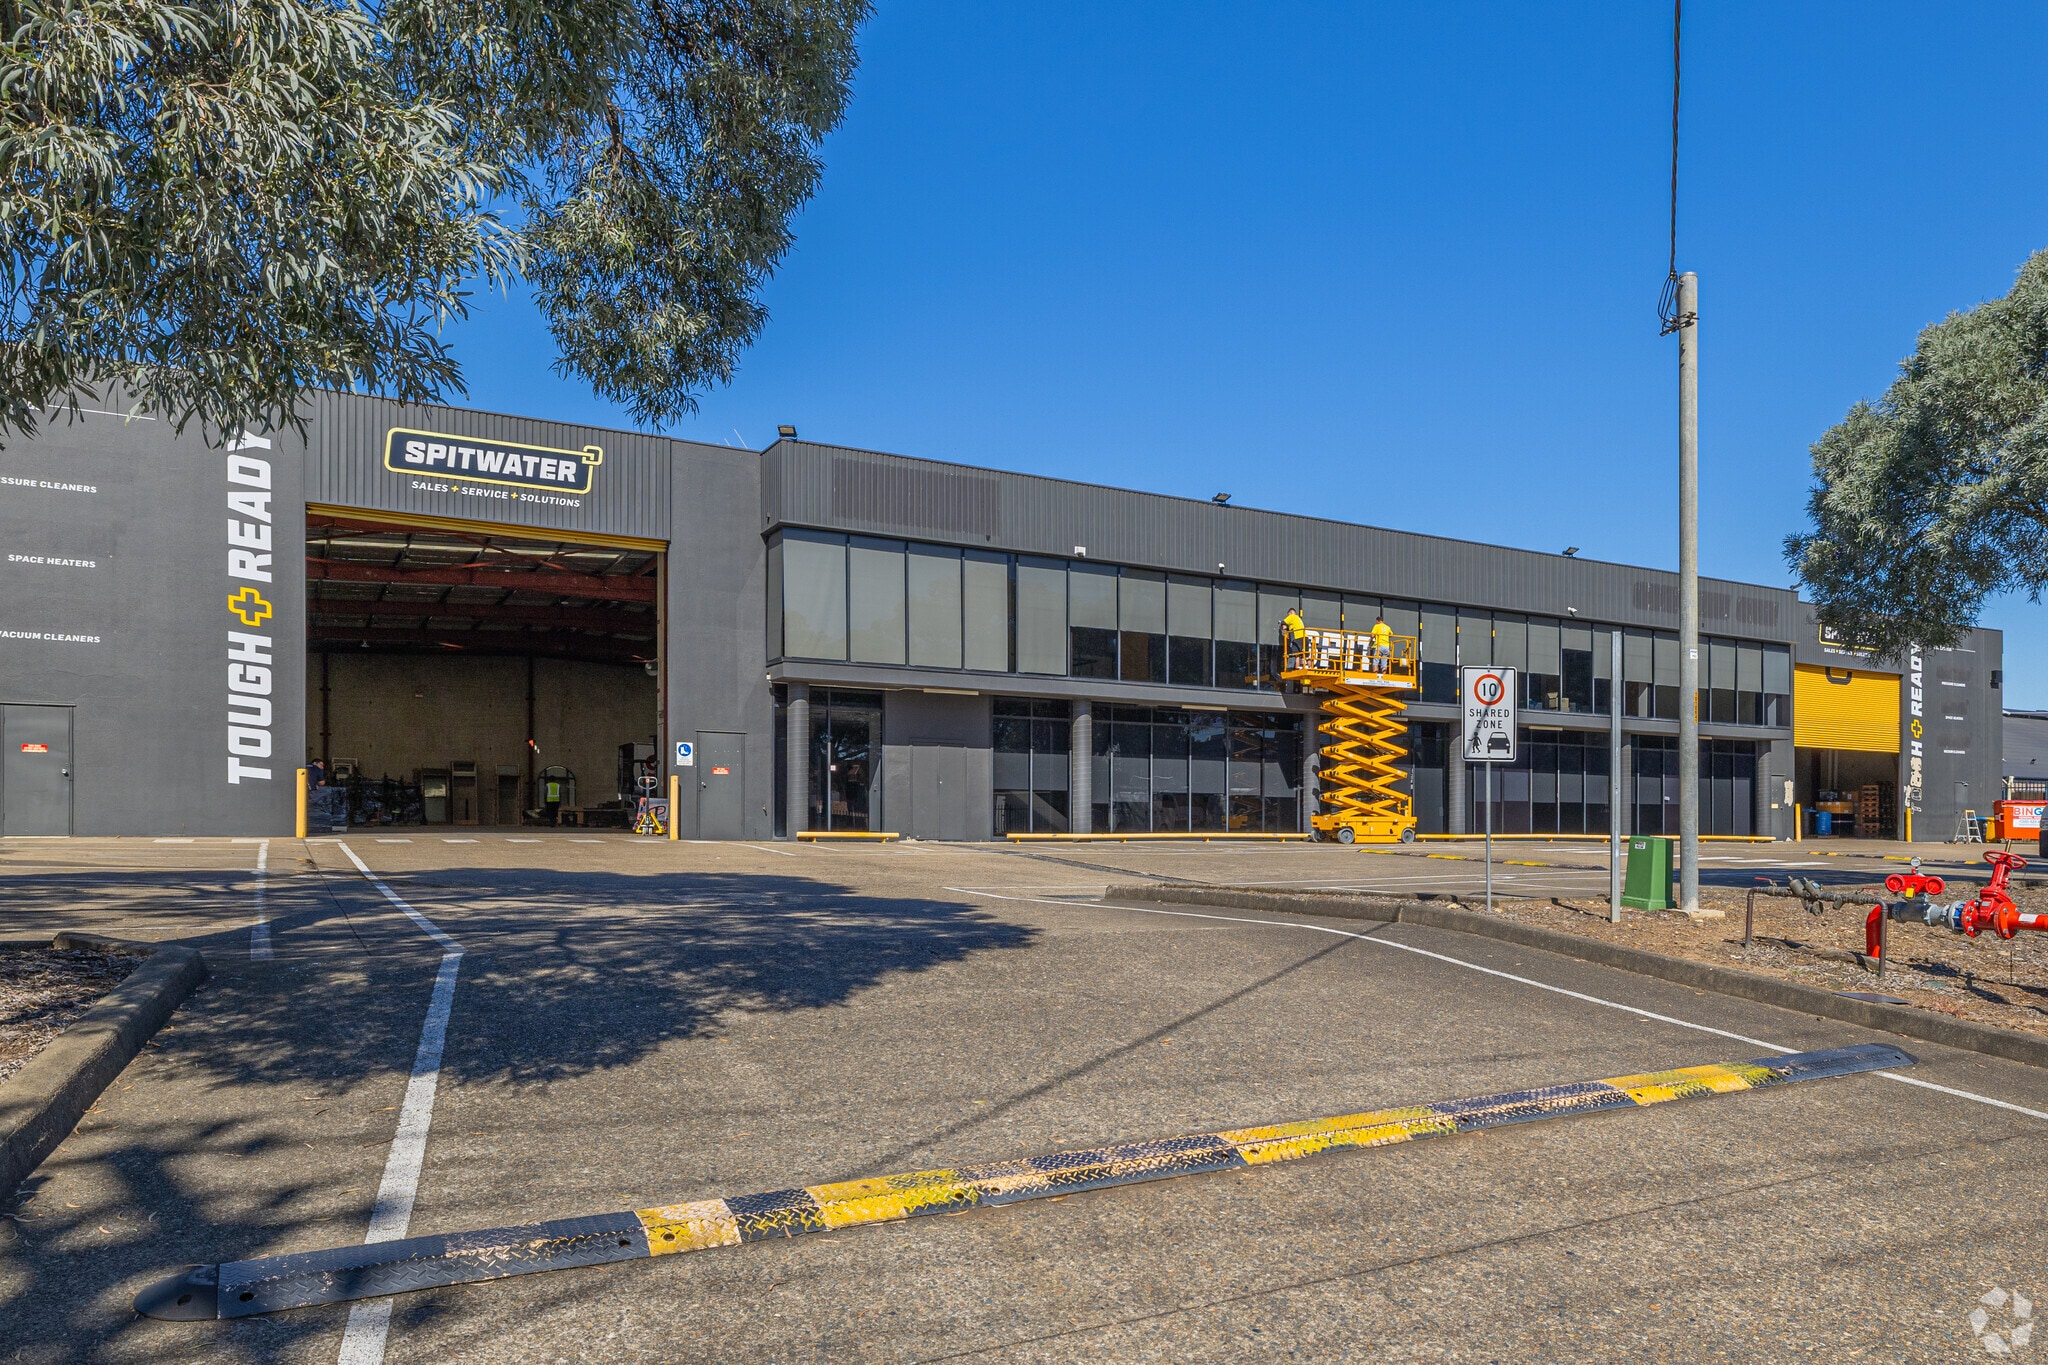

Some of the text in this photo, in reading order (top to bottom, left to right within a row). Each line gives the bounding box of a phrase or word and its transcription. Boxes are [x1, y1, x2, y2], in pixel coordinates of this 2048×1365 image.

[404, 440, 577, 483] SPITWATER
[0, 475, 97, 494] SSURE CLEANERS
[411, 480, 581, 508] SALES SERVICE SOLUTIONS
[8, 554, 96, 568] SPACE HEATERS
[227, 427, 272, 784] TOUGH READY
[43, 633, 101, 643] CLEANERS
[1910, 641, 1923, 717] READY
[1482, 682, 1498, 697] 10
[1469, 708, 1510, 718] SHARED
[1476, 719, 1503, 729] ZONE
